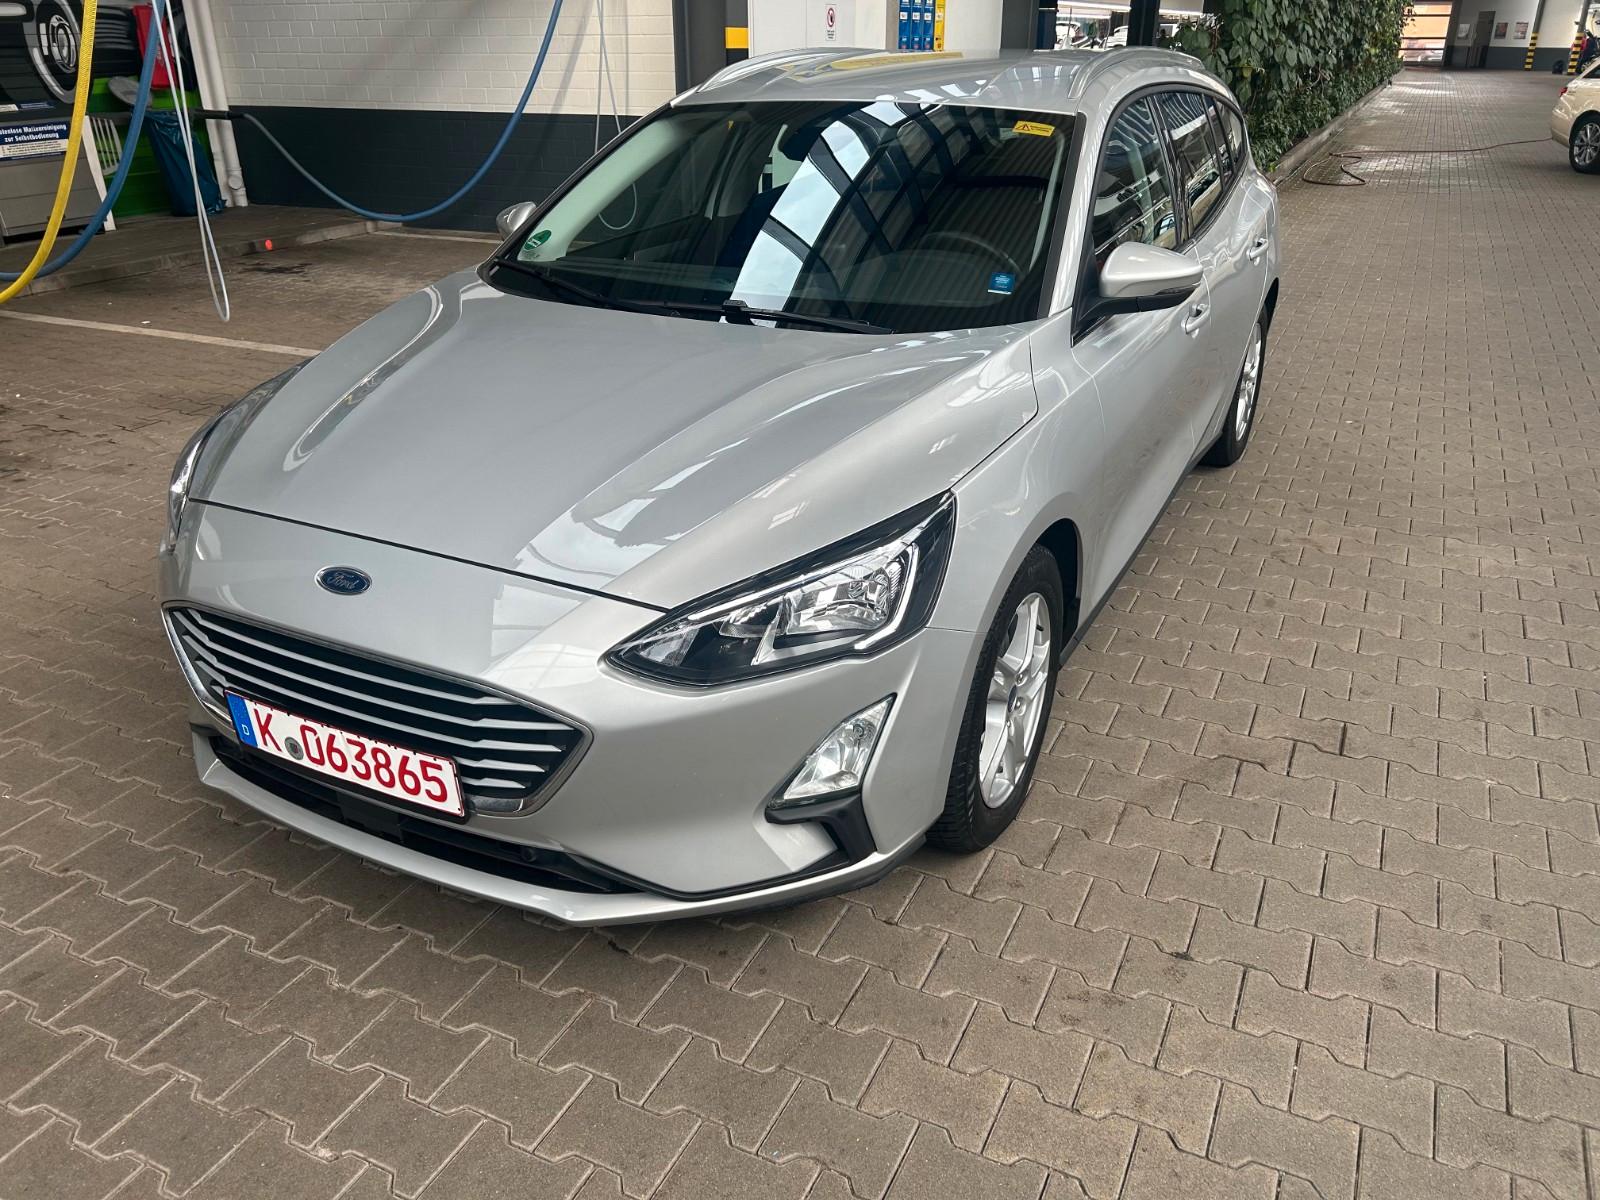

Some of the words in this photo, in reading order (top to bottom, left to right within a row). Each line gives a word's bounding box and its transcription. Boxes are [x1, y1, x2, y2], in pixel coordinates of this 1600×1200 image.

[15, 132, 59, 142] Selbstbedienung
[326, 571, 360, 590] Ford
[242, 724, 250, 736] D
[253, 708, 283, 752] K
[299, 724, 449, 803] 063865
